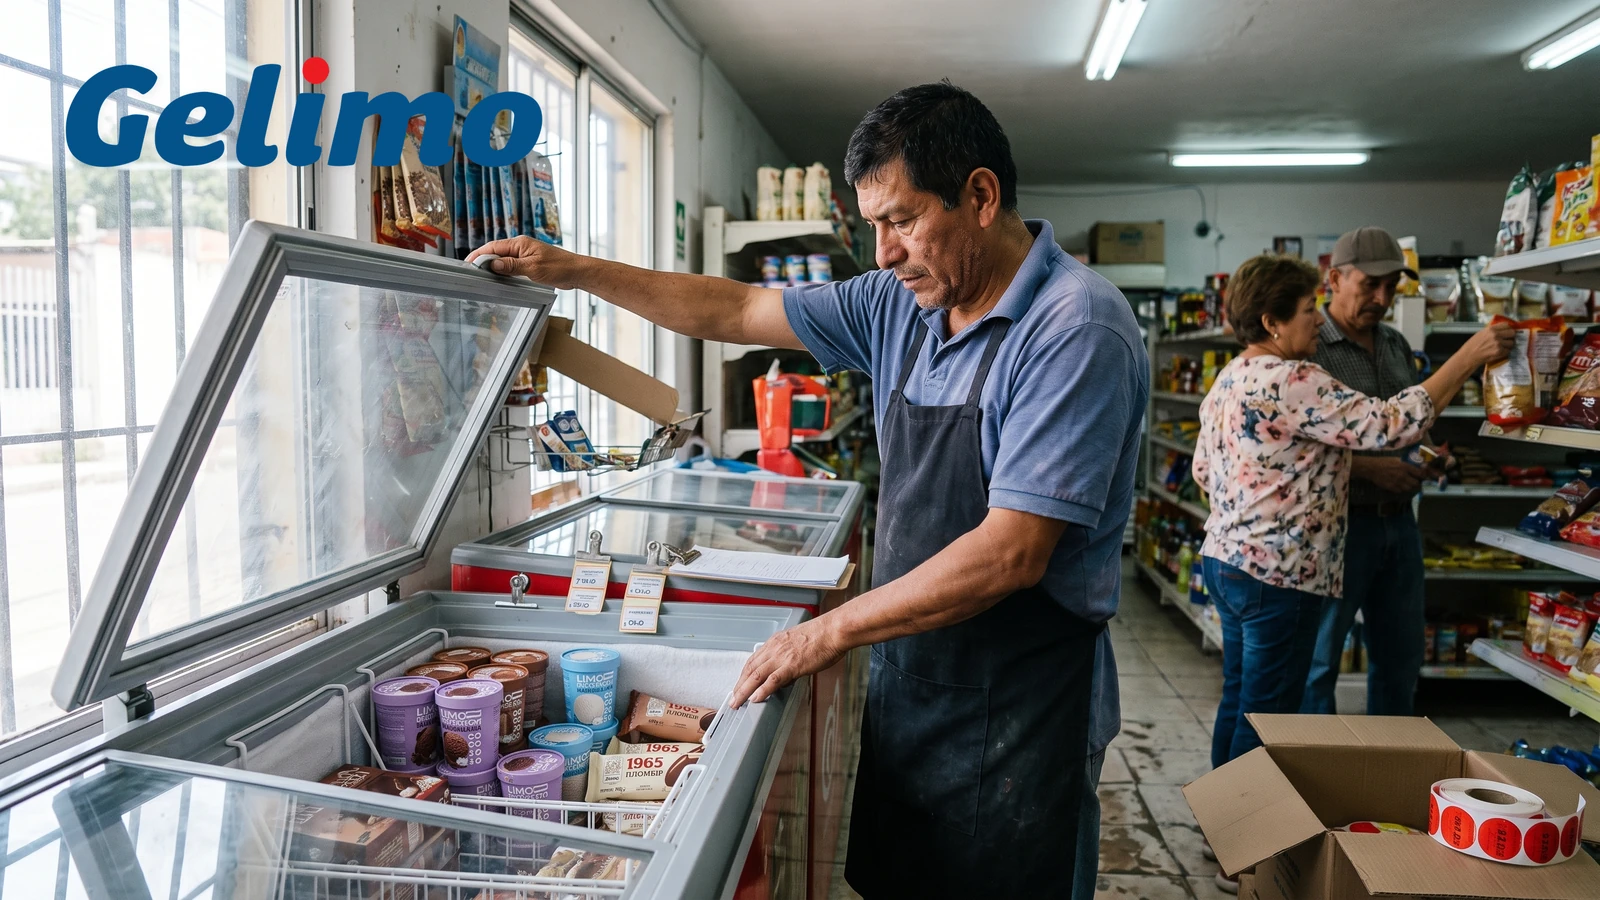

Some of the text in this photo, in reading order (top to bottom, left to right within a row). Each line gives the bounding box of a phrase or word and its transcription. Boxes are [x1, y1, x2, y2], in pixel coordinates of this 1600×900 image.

[646, 743, 680, 753] 1965
[626, 757, 664, 770] 1965
[625, 770, 664, 778] ПЛОМБІР
